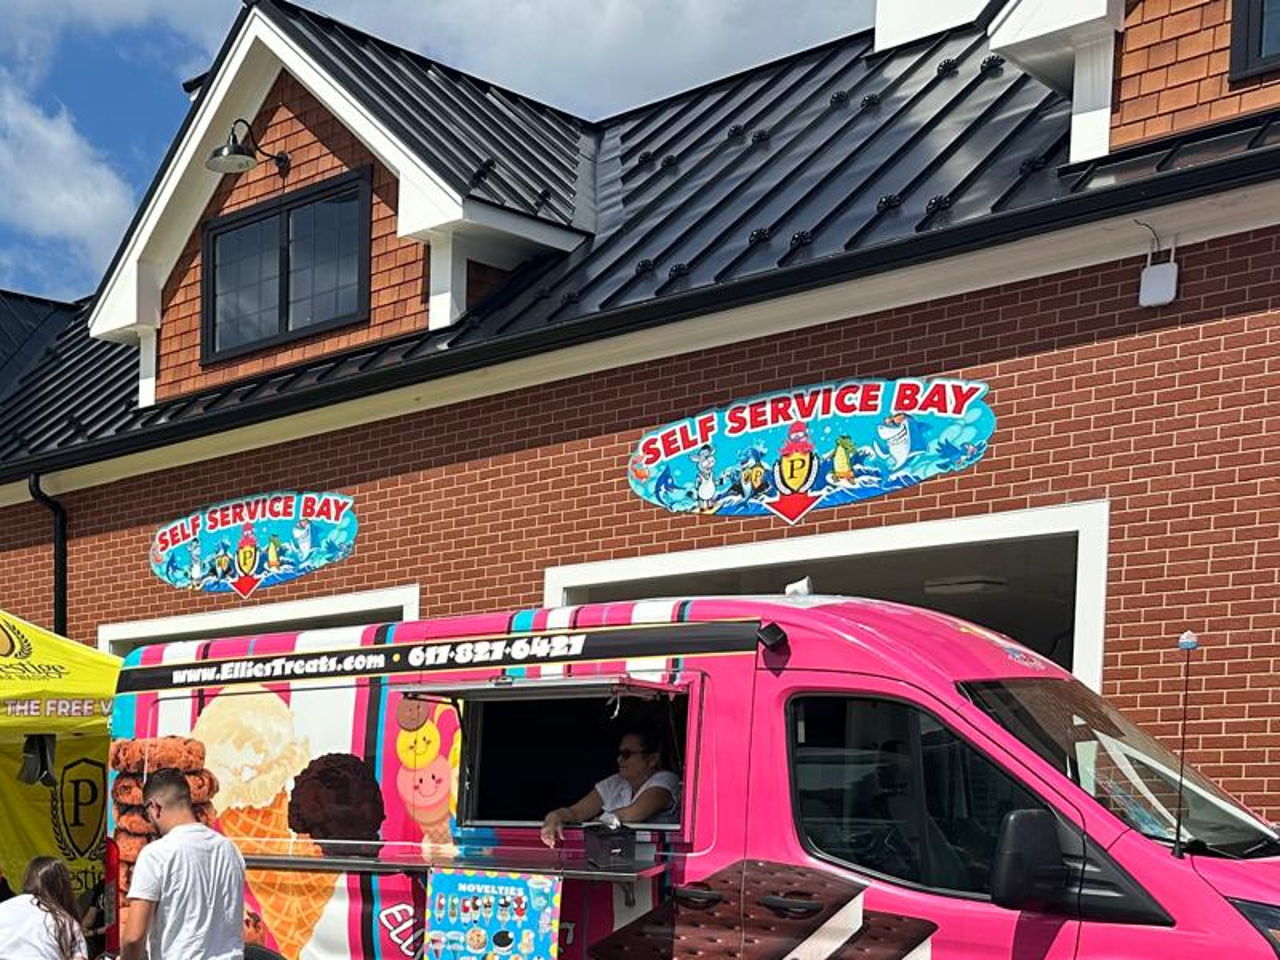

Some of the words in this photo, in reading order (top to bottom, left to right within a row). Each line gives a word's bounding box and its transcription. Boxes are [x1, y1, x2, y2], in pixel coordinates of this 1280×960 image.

[640, 416, 716, 466] SELF
[726, 383, 880, 435] SERVICE
[893, 383, 981, 416] BAY
[157, 515, 202, 552] SELF
[206, 495, 296, 531] SERVICE
[301, 496, 350, 522] BAY
[172, 652, 386, 685] www.ElliesTreats.com
[6, 700, 41, 716] THE
[46, 700, 94, 716] FREE
[69, 778, 98, 827] P
[457, 882, 525, 897] NOVELTIES
